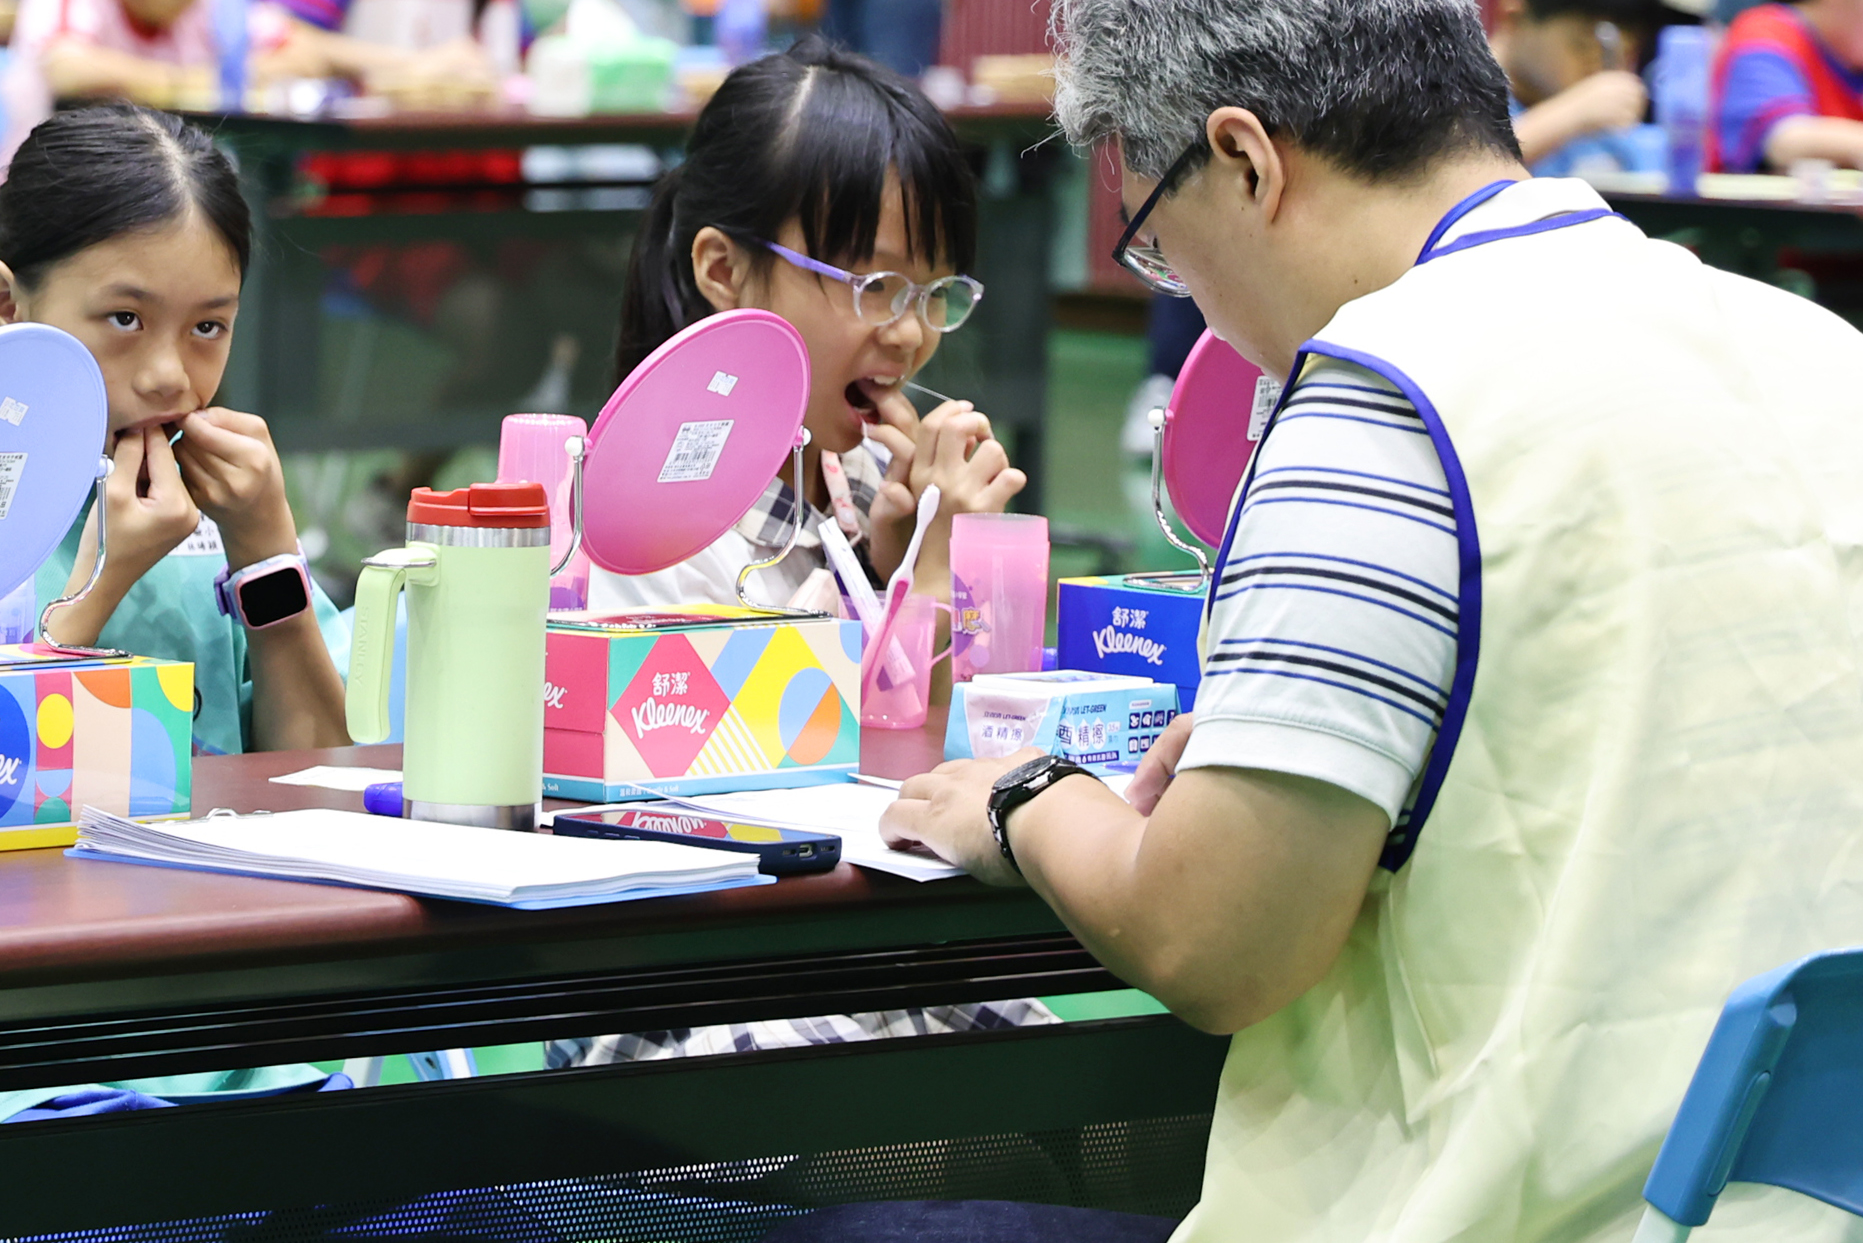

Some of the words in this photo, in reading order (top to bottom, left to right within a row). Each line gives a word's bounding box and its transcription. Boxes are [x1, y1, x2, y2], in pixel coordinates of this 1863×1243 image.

[1111, 606, 1149, 628] 舒潔
[355, 605, 369, 686] STANLEY
[1092, 625, 1167, 666] Kleenex
[652, 671, 690, 698] 舒潔
[631, 697, 710, 739] Kleenex
